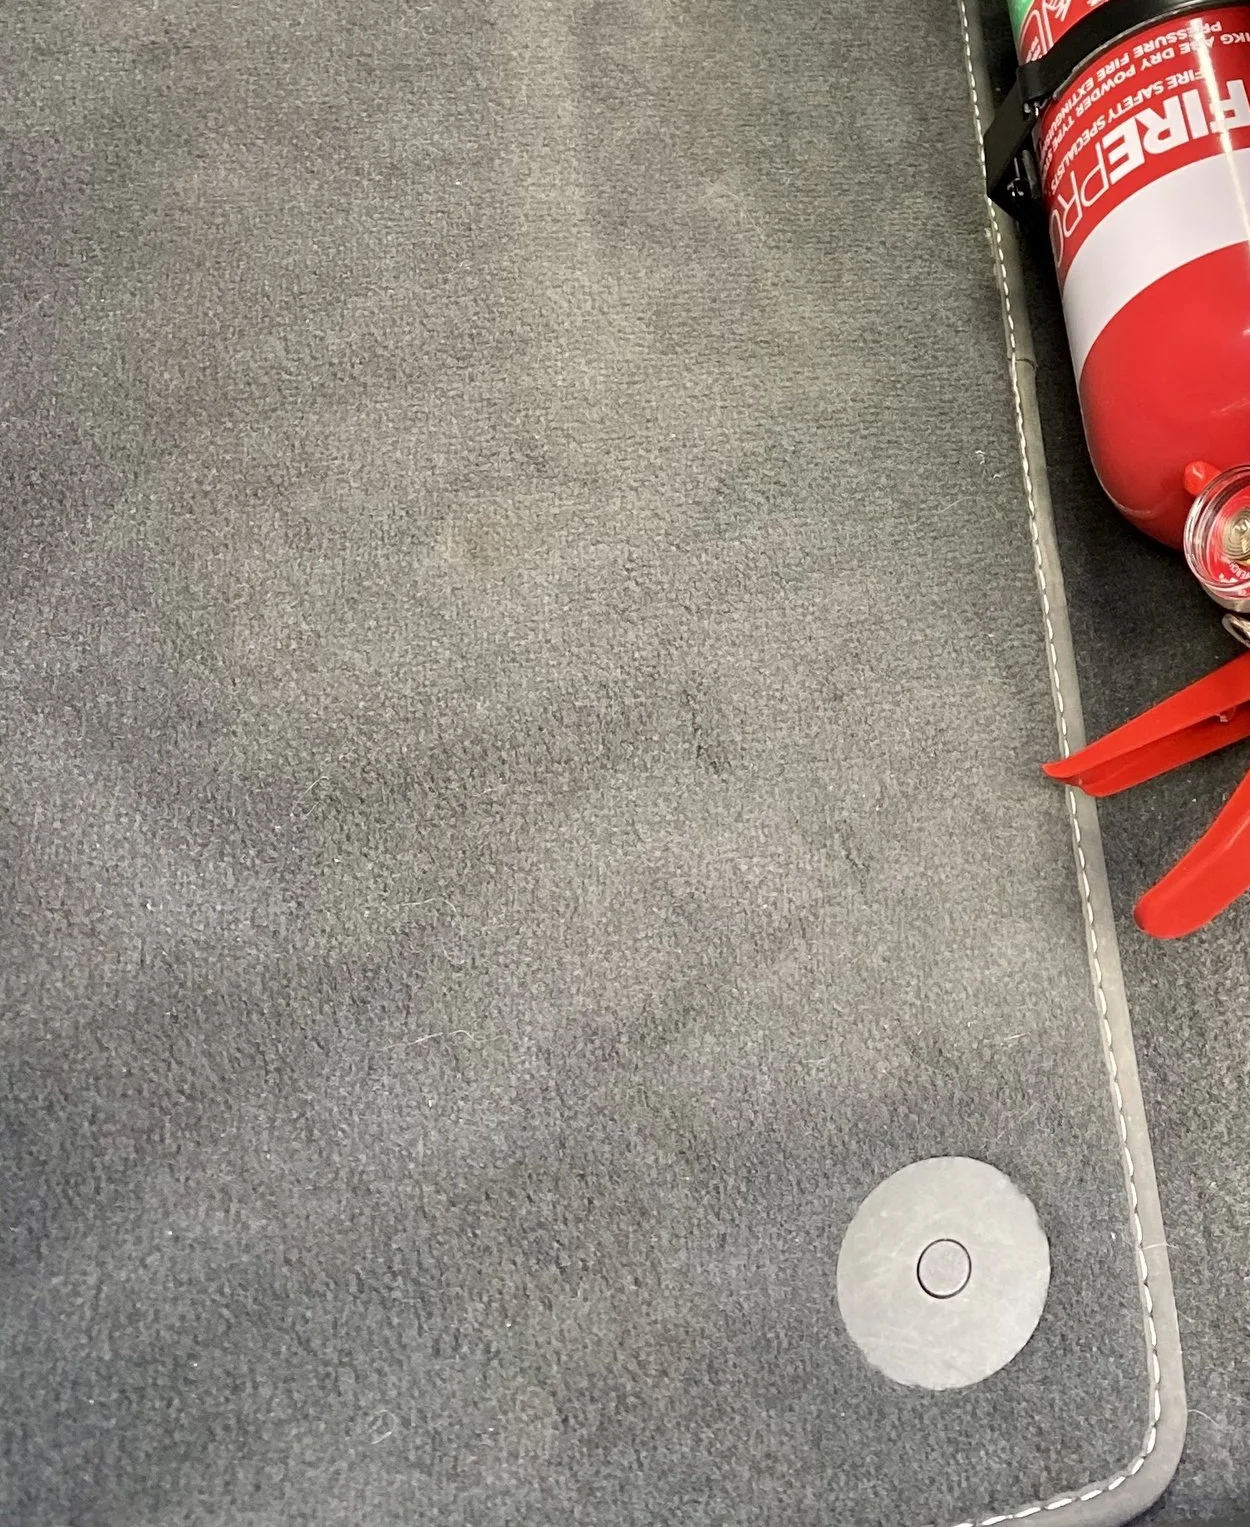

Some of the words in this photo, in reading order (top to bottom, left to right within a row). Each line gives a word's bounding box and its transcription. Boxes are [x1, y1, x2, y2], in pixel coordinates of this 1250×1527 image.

[1134, 20, 1223, 59] PRESSURE
[1096, 53, 1130, 75] FIRE
[1140, 48, 1176, 71] DRY
[1167, 67, 1208, 90] FIRE
[1075, 64, 1137, 117] POWDER
[1105, 78, 1165, 125] SAFETY
[1051, 115, 1075, 153] TYPE
[1051, 115, 1106, 194] SPECIALISTS
